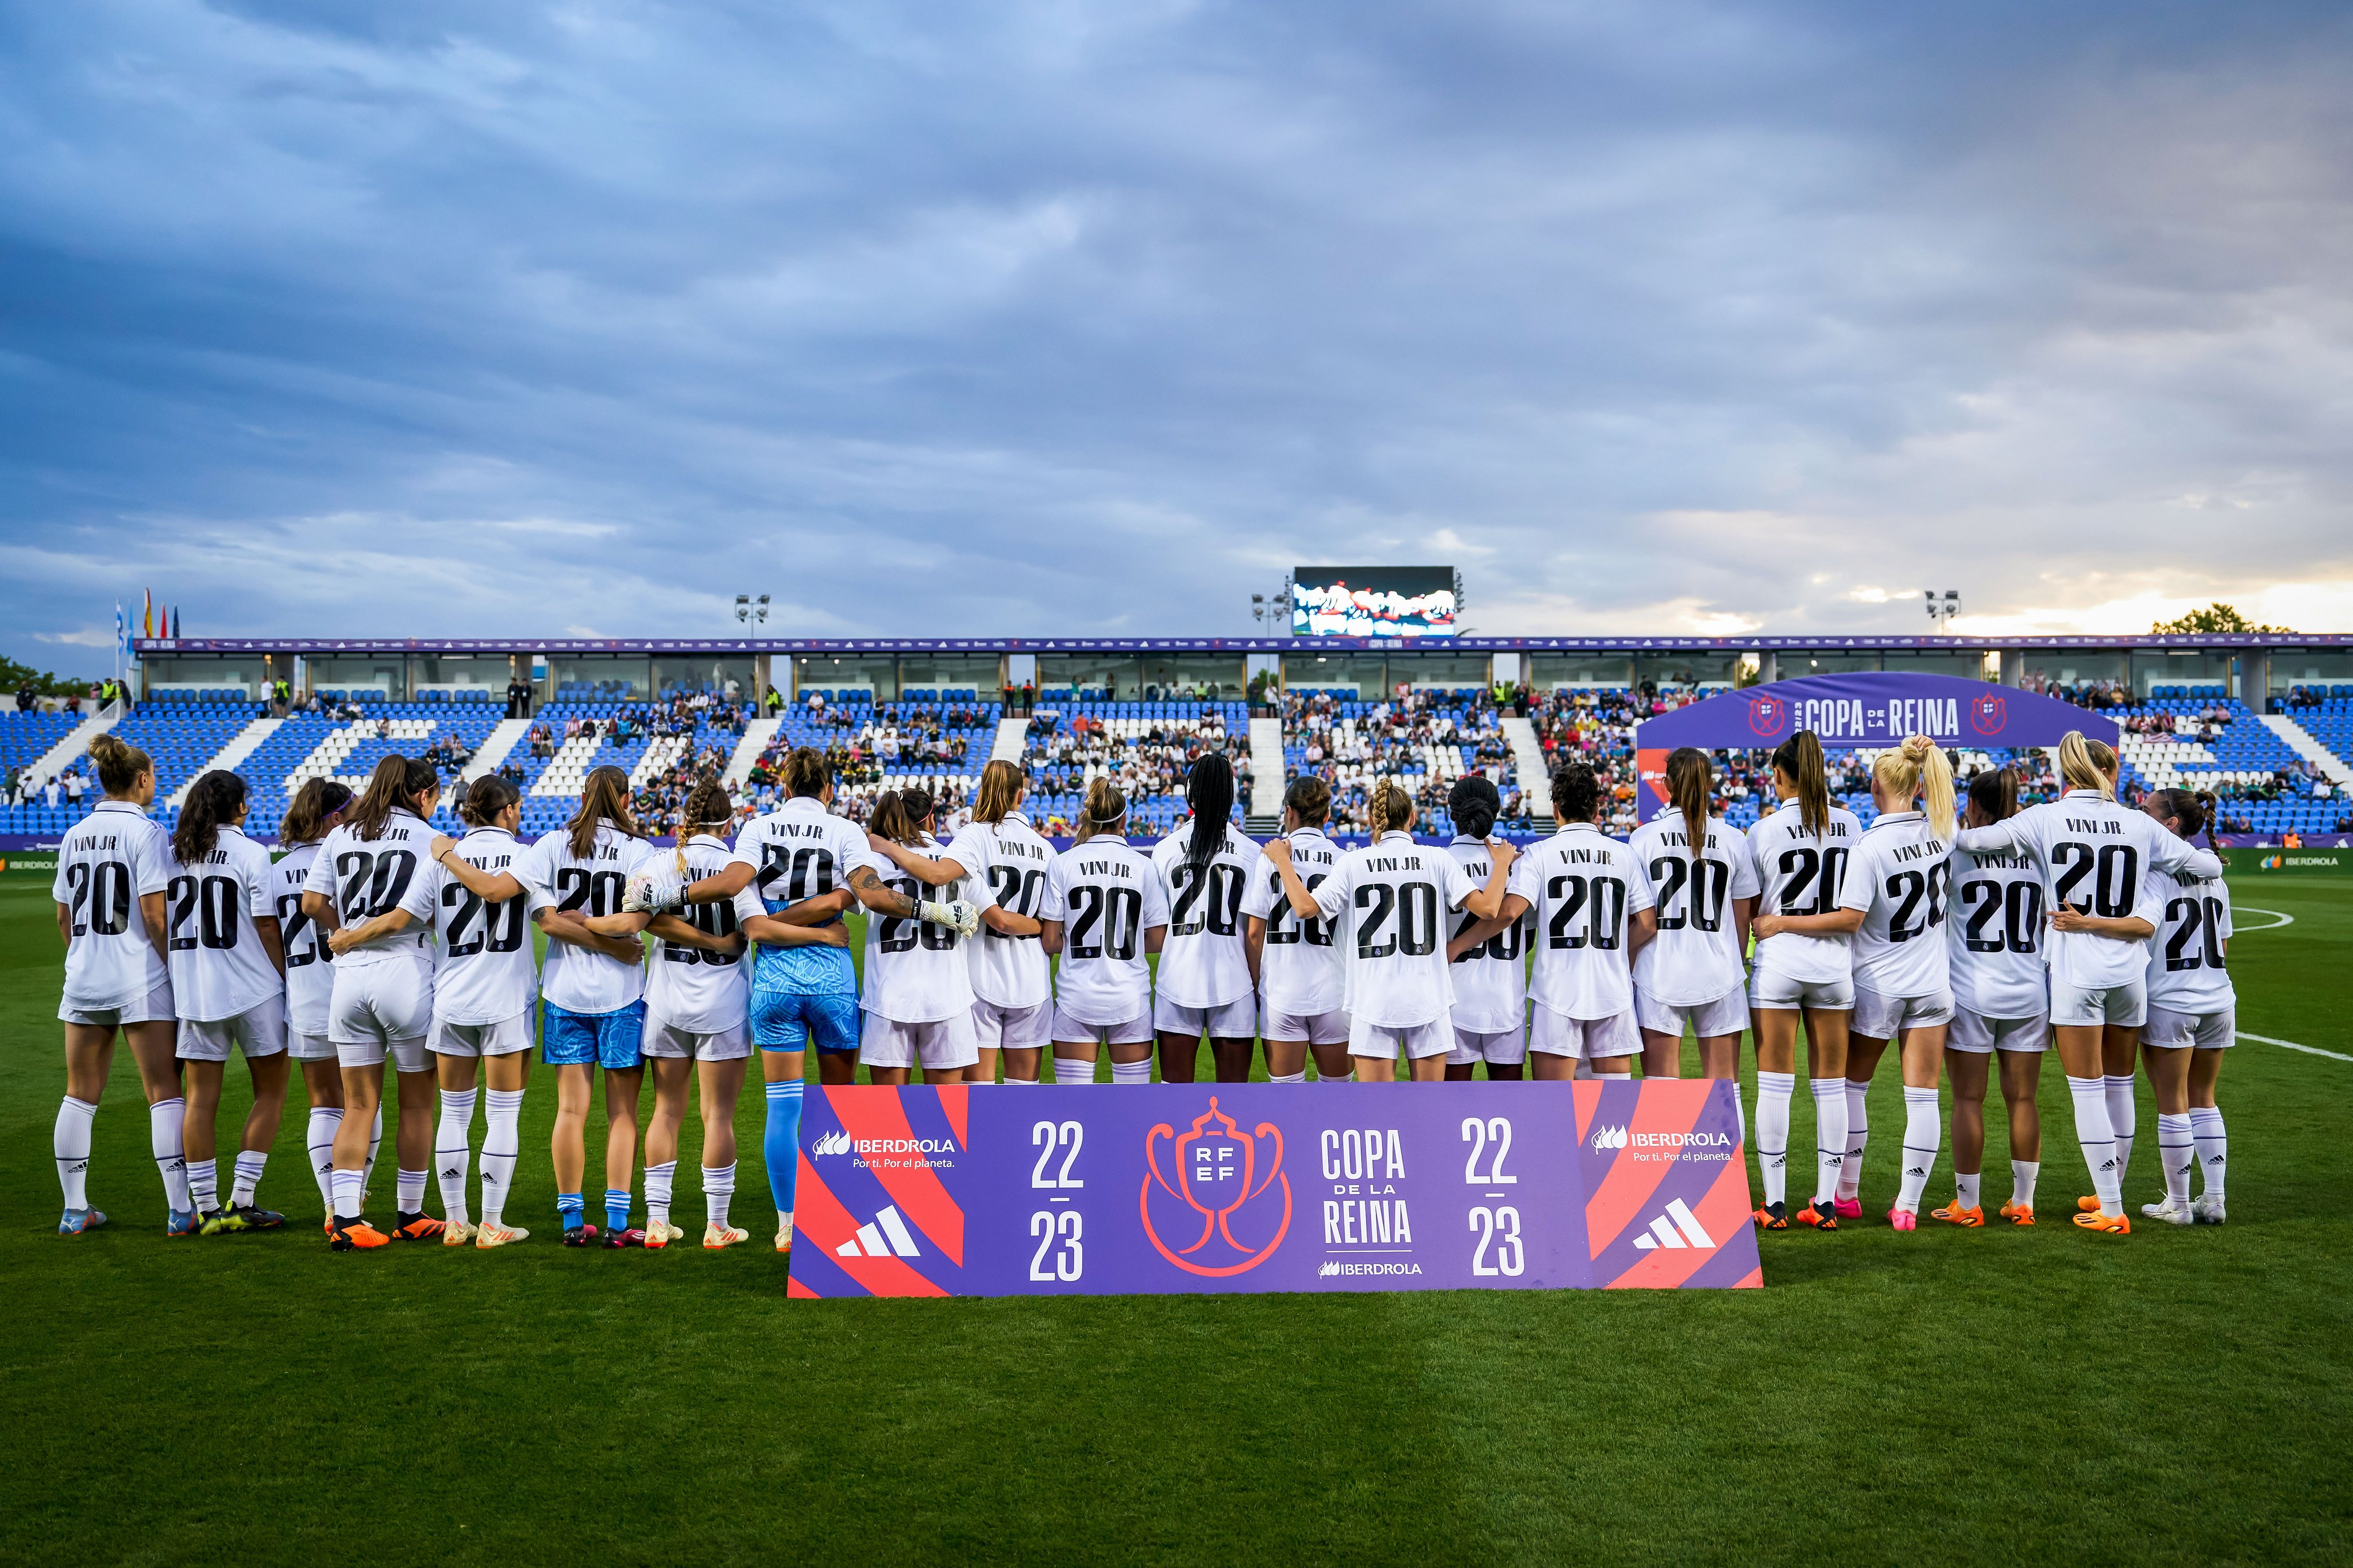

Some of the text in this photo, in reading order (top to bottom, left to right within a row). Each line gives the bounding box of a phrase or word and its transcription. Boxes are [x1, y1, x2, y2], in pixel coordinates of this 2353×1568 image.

[1805, 699, 1865, 737] COPA
[1889, 698, 1959, 736] REINA
[75, 836, 118, 852] VINI JR.
[387, 828, 410, 841] JR.
[771, 822, 824, 840] VINI JR.
[1827, 822, 1849, 837] JR.
[2066, 818, 2126, 835] VINI JR.
[998, 840, 1046, 862] VINI JR.
[1080, 861, 1132, 879] VINI JR.
[1366, 856, 1424, 872] VINI JR.
[1560, 849, 1614, 866] VINI JR.
[1892, 844, 1922, 863] VINI
[1973, 853, 2033, 870] VINI JR.
[2285, 857, 2339, 866] IBERDROLA
[67, 861, 130, 936] 20
[336, 849, 417, 926] 20
[1171, 863, 1247, 937] 20
[1649, 856, 1729, 932] 20
[1779, 847, 1850, 916] 20
[1885, 856, 1951, 943] 20
[2051, 842, 2138, 918] 20
[167, 875, 238, 949] 20
[441, 882, 526, 957] 20
[880, 878, 958, 953] 20
[1068, 885, 1142, 960] 20
[1355, 882, 1436, 959] 20
[1548, 875, 1626, 950] 20
[1961, 879, 2042, 953] 20
[2165, 896, 2226, 972] 20
[854, 1139, 956, 1153] IBERDROLA
[1031, 1121, 1084, 1188] 22
[1321, 1129, 1406, 1180] COPA
[1461, 1117, 1518, 1184] 22
[1631, 1133, 1731, 1147] IBERDROLA
[1633, 1151, 1734, 1163] Por ti. Por el planeta.
[853, 1158, 955, 1170] Por ti. Por el planeta.
[1905, 1170, 1927, 1178] adidas
[1334, 1184, 1396, 1195] DE LA
[1323, 1199, 1412, 1244] REINA
[1468, 1206, 1526, 1277] 23
[1029, 1210, 1083, 1282] 23
[1341, 1262, 1423, 1276] IBERDROLA
